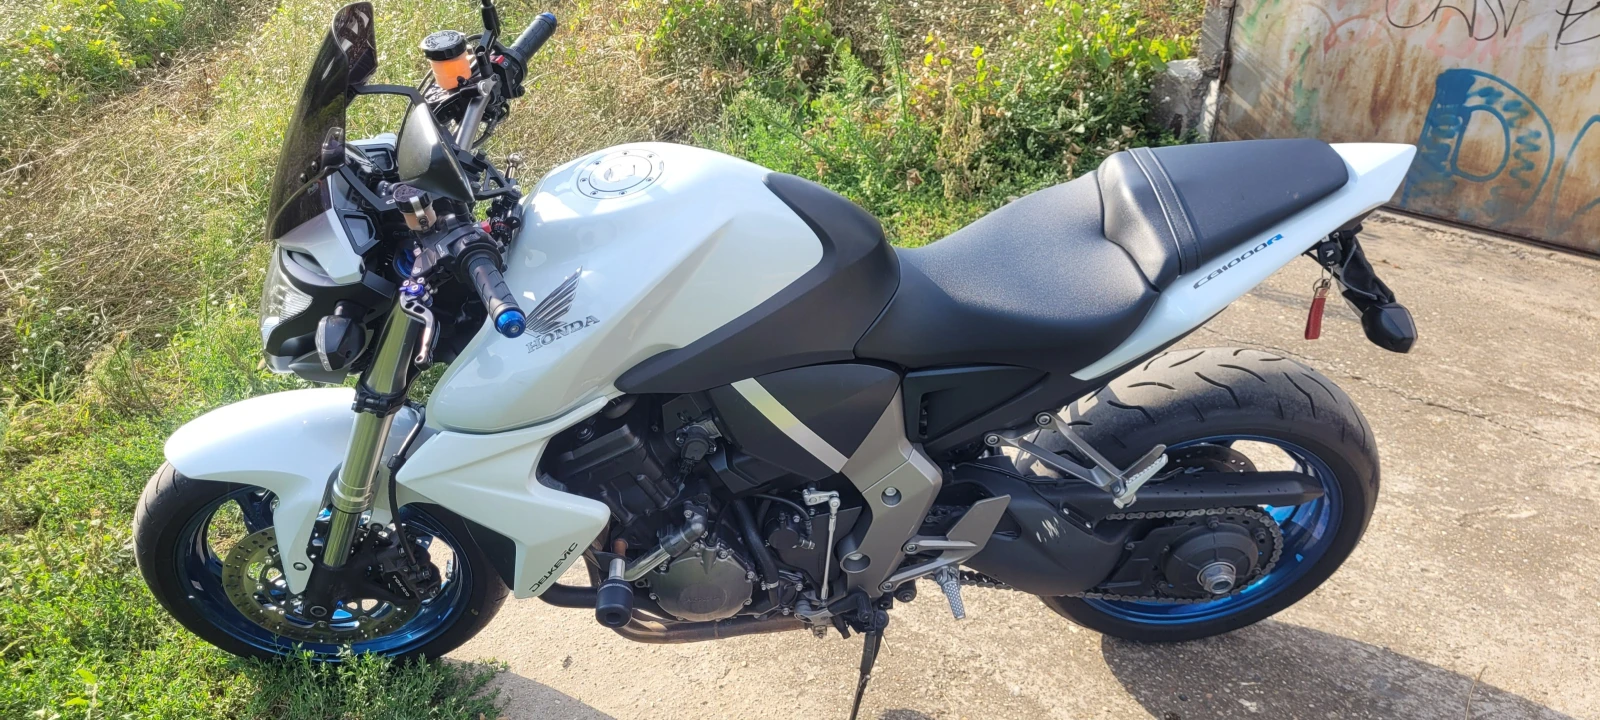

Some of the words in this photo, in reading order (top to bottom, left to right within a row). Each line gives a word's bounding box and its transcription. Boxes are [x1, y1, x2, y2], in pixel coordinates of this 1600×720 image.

[1193, 233, 1284, 290] CB1000R
[525, 315, 600, 354] HONDA
[528, 541, 578, 593] DELKEVIC
